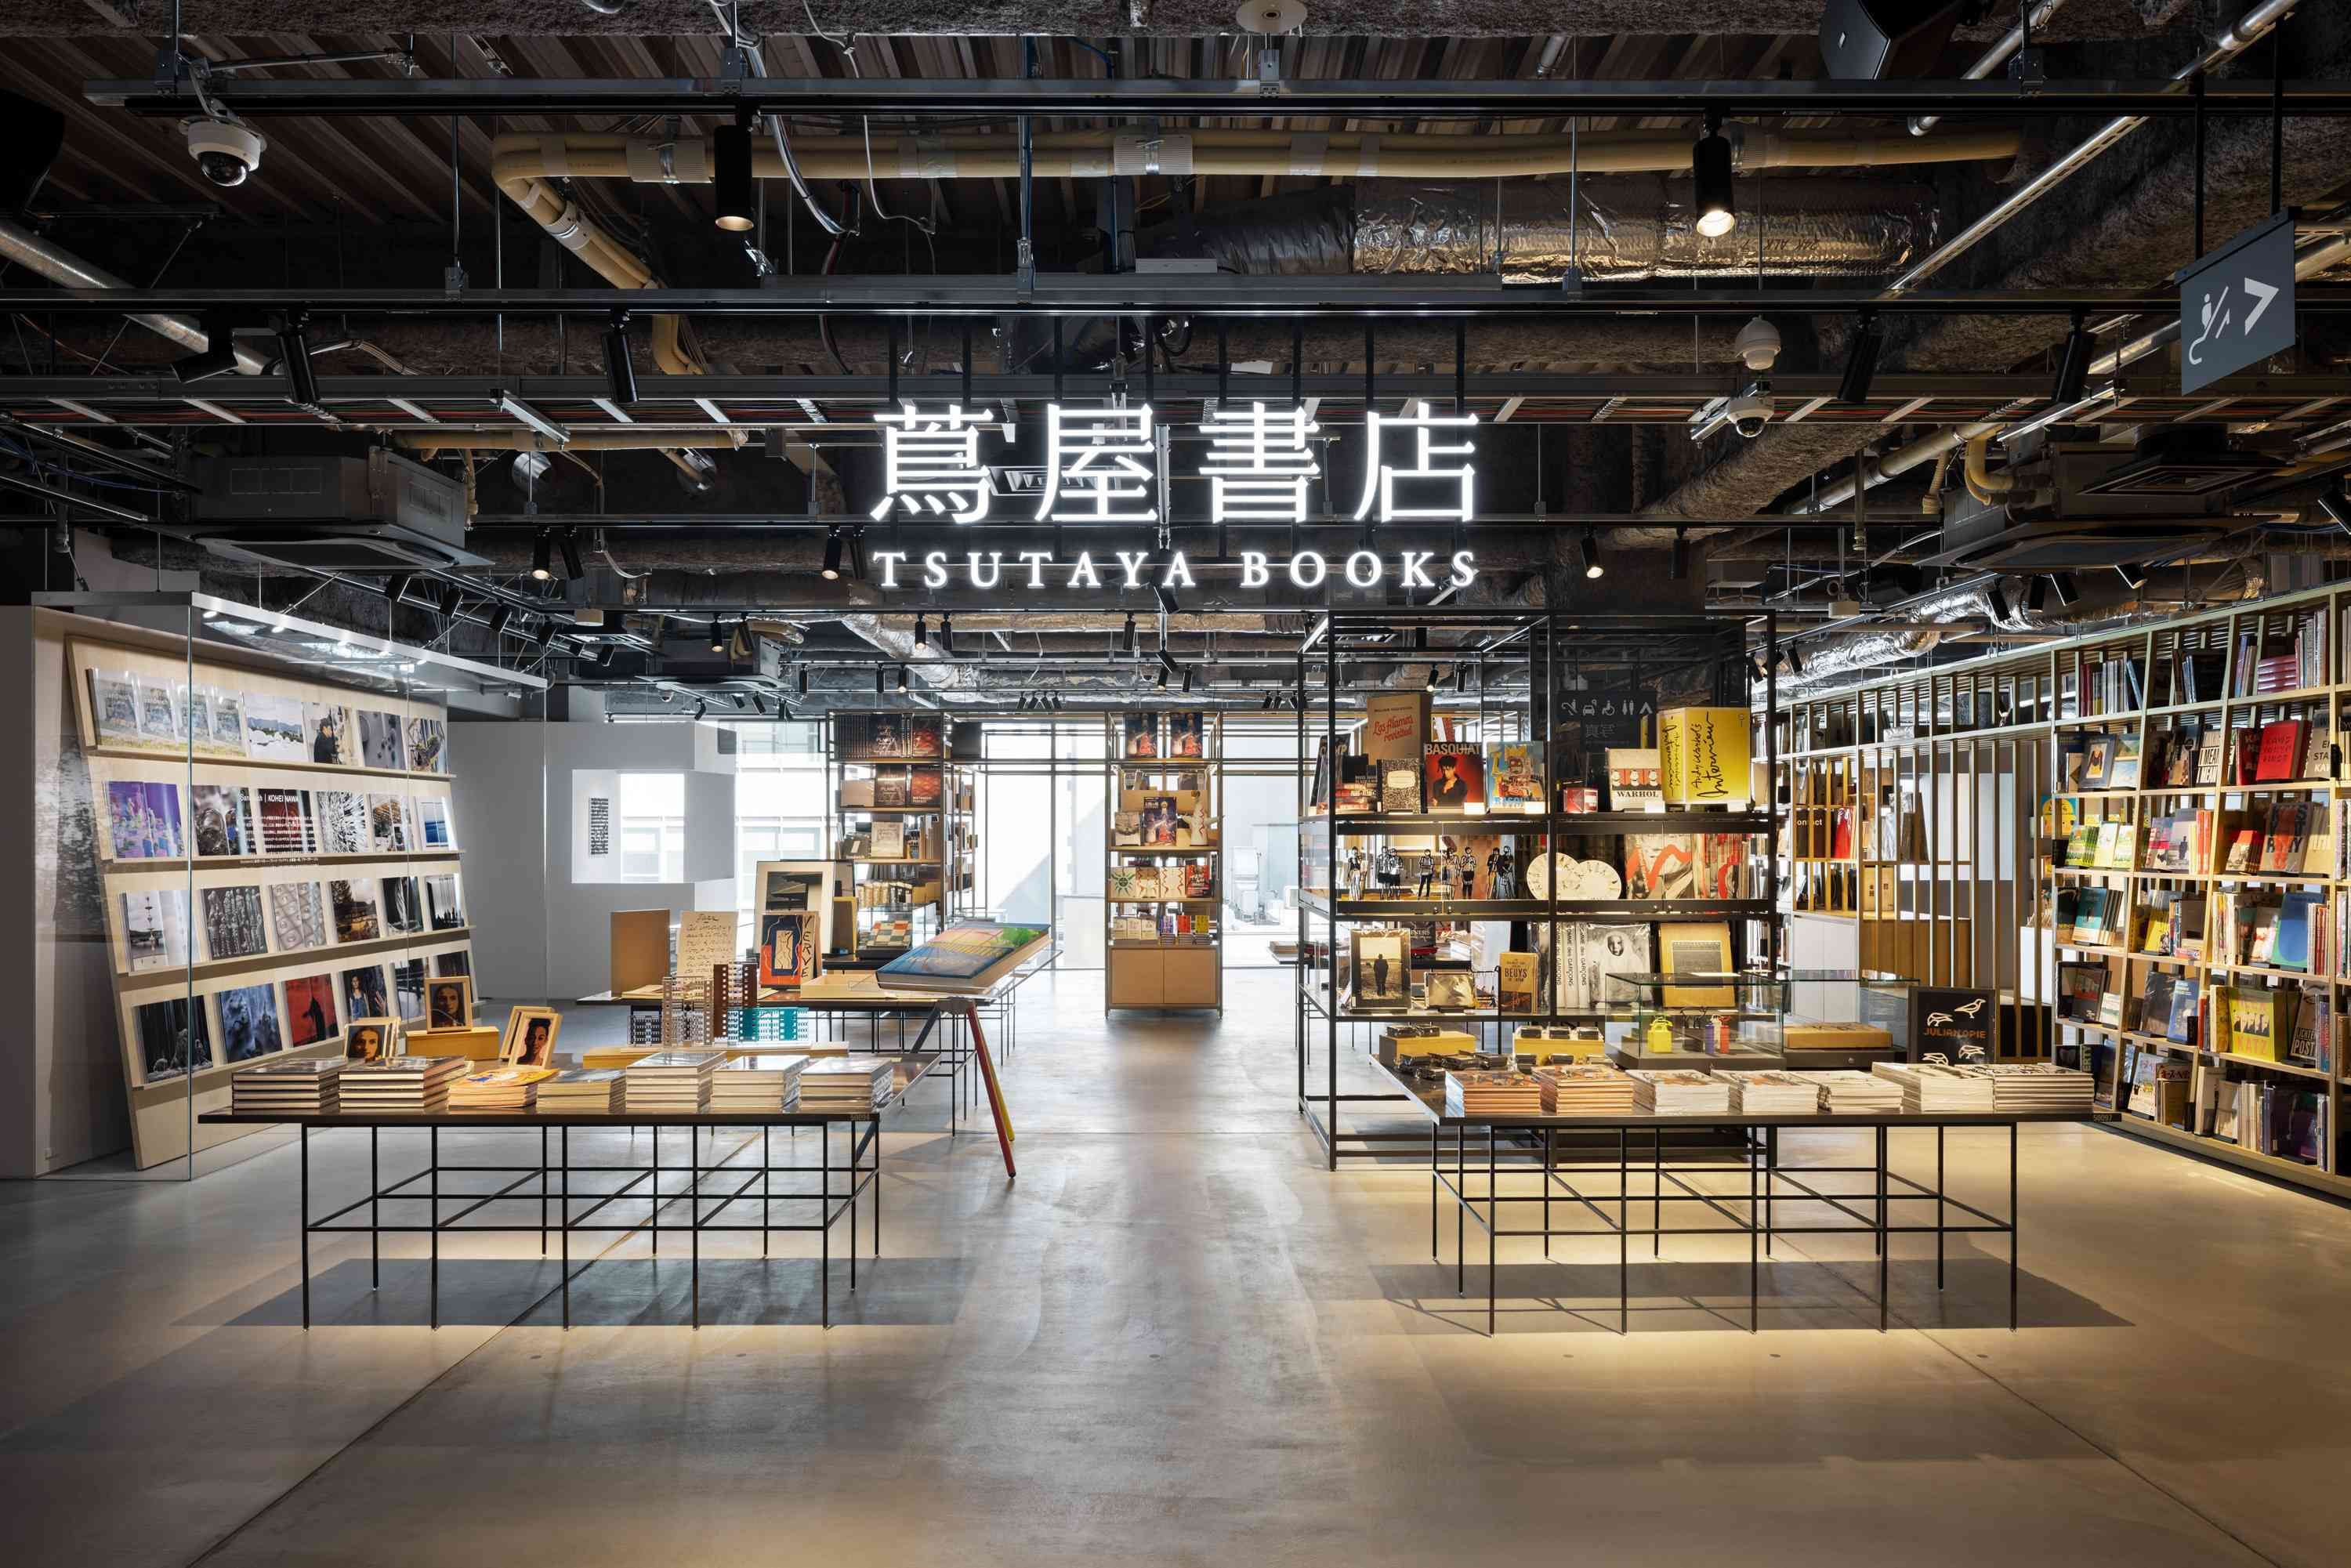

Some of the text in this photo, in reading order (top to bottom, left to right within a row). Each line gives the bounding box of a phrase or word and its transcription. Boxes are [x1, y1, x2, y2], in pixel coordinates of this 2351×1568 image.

[870, 401, 1479, 523] 蔦屋書店
[873, 550, 1477, 588] TSUTAYA BOOKS
[1425, 744, 1481, 755] BASQUIAT
[1697, 712, 1728, 798] Interview
[802, 915, 812, 978] VERVE
[1505, 968, 1527, 979] BEUYS
[1924, 1027, 1987, 1039] JULIAN OPIE
[2295, 1041, 2316, 1056] POST
